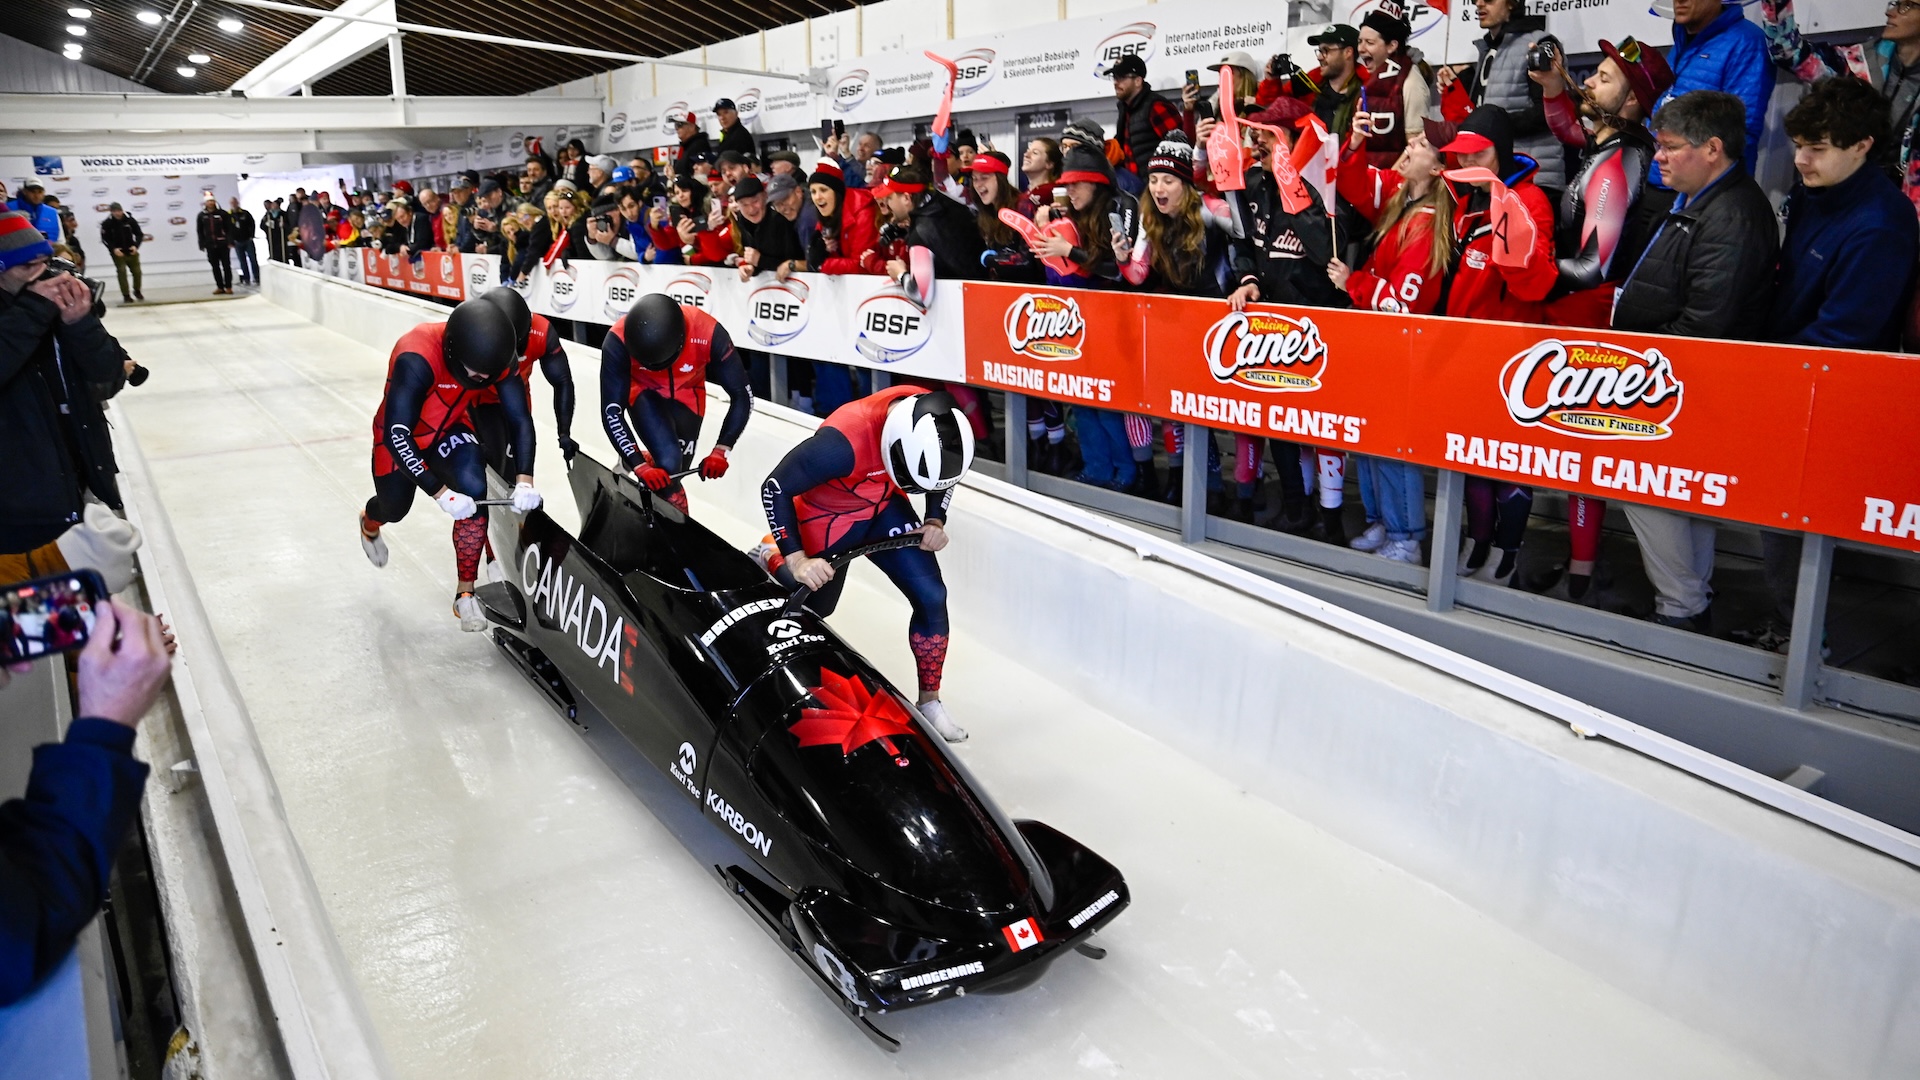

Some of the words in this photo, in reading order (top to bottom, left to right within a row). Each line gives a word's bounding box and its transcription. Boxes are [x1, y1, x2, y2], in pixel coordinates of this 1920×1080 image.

[1165, 29, 1222, 44] International
[1224, 21, 1272, 37] Bobsleigh
[1003, 54, 1043, 69] International
[1044, 49, 1080, 63] Bobsleigh
[1165, 46, 1172, 57] &
[1173, 41, 1211, 55] Skeleton
[1213, 37, 1264, 52] Federation
[876, 75, 909, 87] International
[956, 65, 988, 80] BSF
[1009, 67, 1036, 78] Skeleton
[1037, 62, 1075, 74] Federation
[837, 84, 864, 98] IBSF
[904, 82, 930, 92] Federation
[1029, 112, 1056, 129] 2003
[81, 158, 124, 167] WORLD
[126, 157, 210, 166] CHAMPIONSHIP
[1595, 177, 1611, 220] KARBON
[1494, 211, 1510, 255] A
[553, 281, 574, 295] IBSF
[608, 286, 635, 302] IBSF
[1400, 272, 1423, 302] 6
[754, 301, 800, 322] IBSF
[1009, 294, 1083, 351] Cane's
[865, 312, 920, 336] IBSF
[1250, 317, 1290, 336] Raising
[1209, 311, 1326, 380] Cane's
[1568, 347, 1629, 370] Raising
[983, 361, 1044, 391] RAISING
[1047, 371, 1112, 402] CANE'S
[1245, 370, 1276, 383] CHICKEN
[1278, 375, 1311, 387] FINGERS
[1508, 340, 1680, 422] Cane's
[1170, 389, 1262, 429] RAISING
[1268, 405, 1361, 444] CANE'S
[1560, 412, 1605, 428] CHICKEN
[1608, 418, 1656, 434] FINGERS
[605, 402, 637, 457] Canada
[390, 423, 425, 478] Canada
[437, 432, 480, 459] CAN
[1318, 453, 1343, 478] R
[1445, 432, 1582, 483] RAISING
[1591, 455, 1728, 507] CANE'S
[762, 477, 784, 542] Canada
[522, 543, 623, 685] CANADA
[799, 633, 826, 643] Tec
[670, 761, 687, 786] Kuri
[686, 778, 701, 799] Tec
[706, 788, 773, 858] KARBON
[1068, 889, 1120, 930] BRIDGEMANS
[900, 960, 985, 991] BRIDGEMANS
